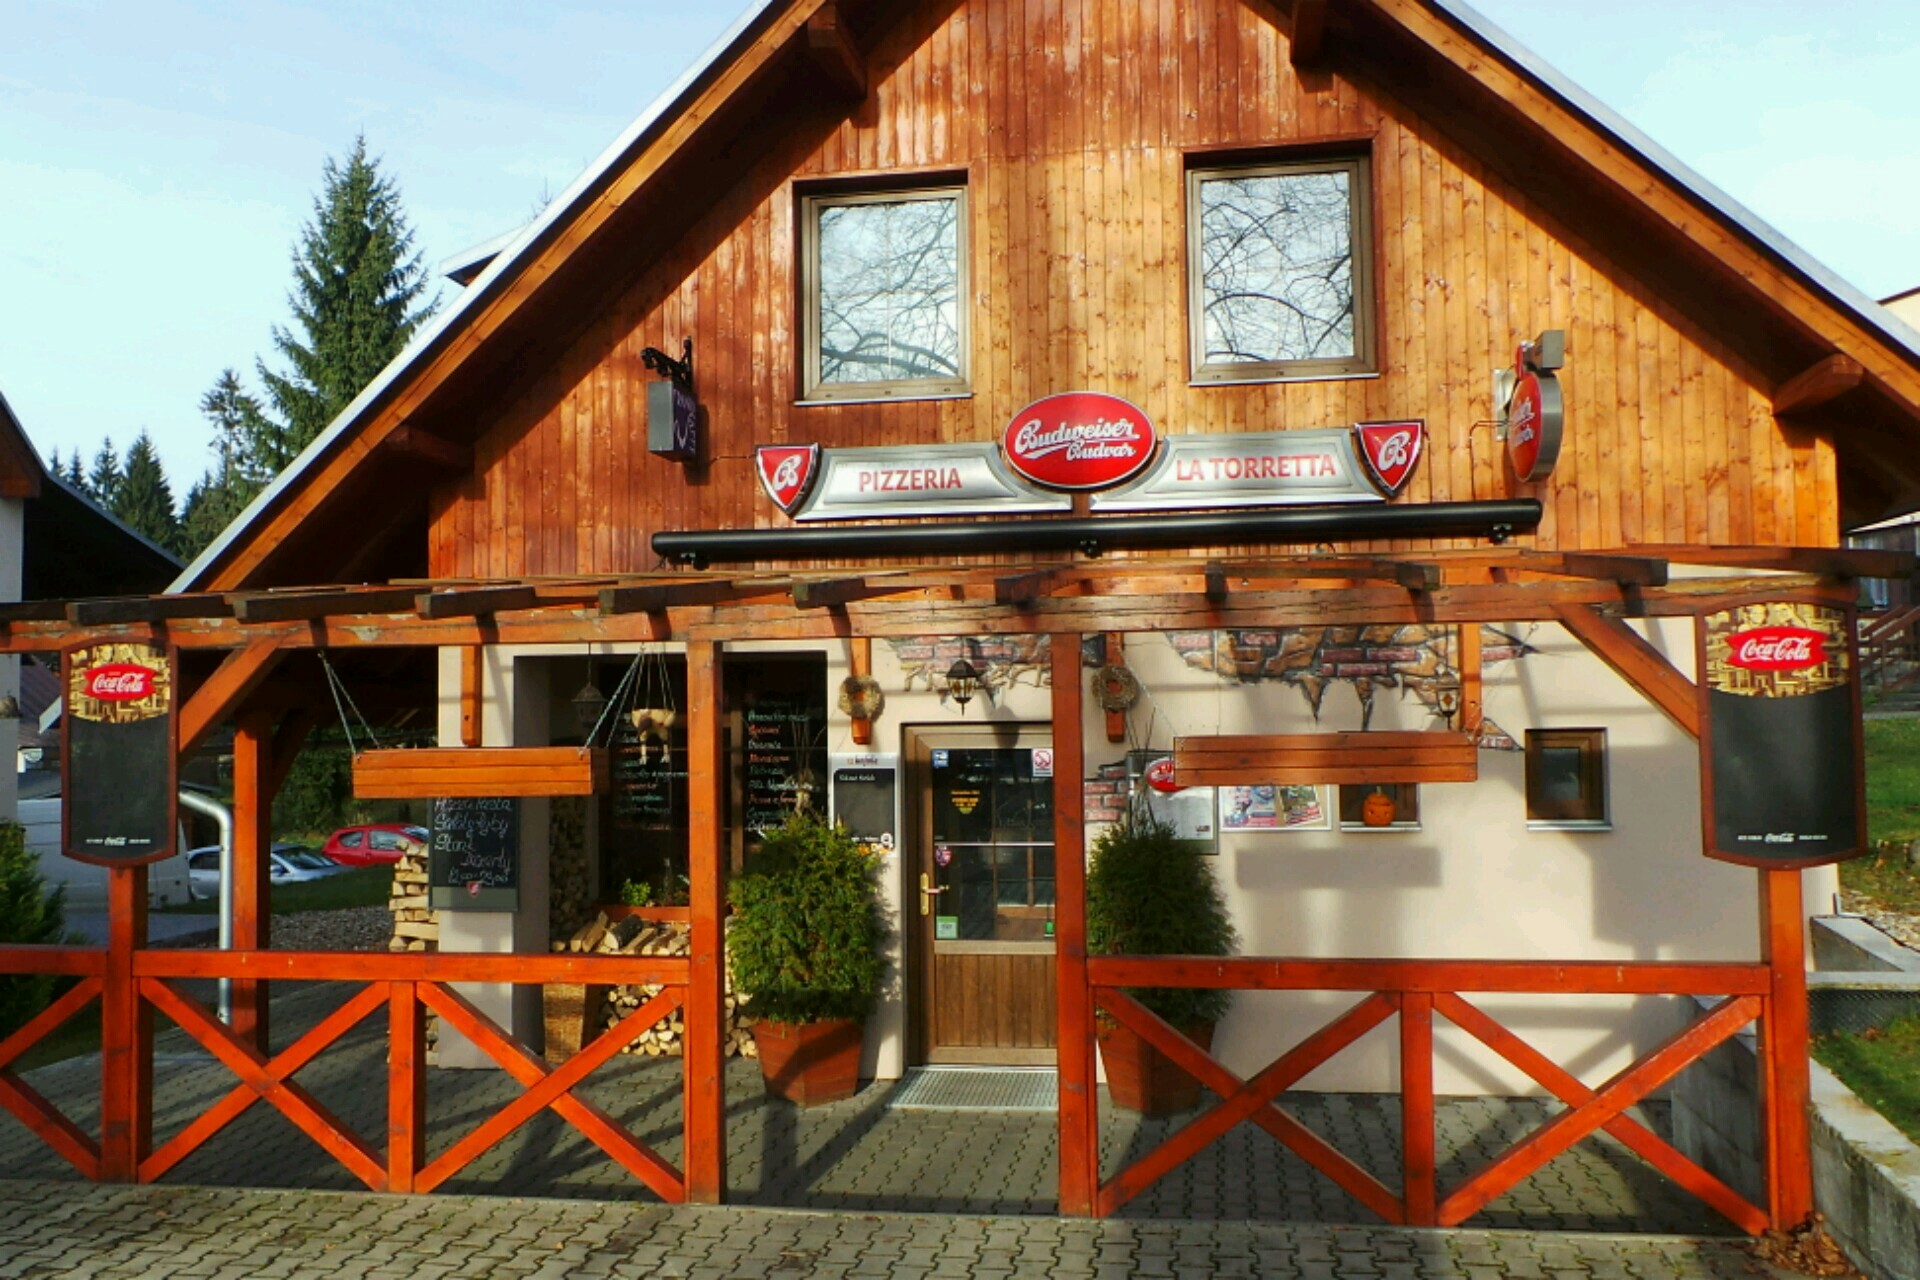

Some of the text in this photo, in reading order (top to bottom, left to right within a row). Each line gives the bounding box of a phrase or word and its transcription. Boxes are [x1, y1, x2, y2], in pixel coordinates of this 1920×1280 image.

[1015, 418, 1139, 455] Budweiser
[1066, 440, 1136, 461] Budvar
[859, 467, 963, 493] PIZZERIA
[1176, 454, 1337, 481] LA TORRETTA
